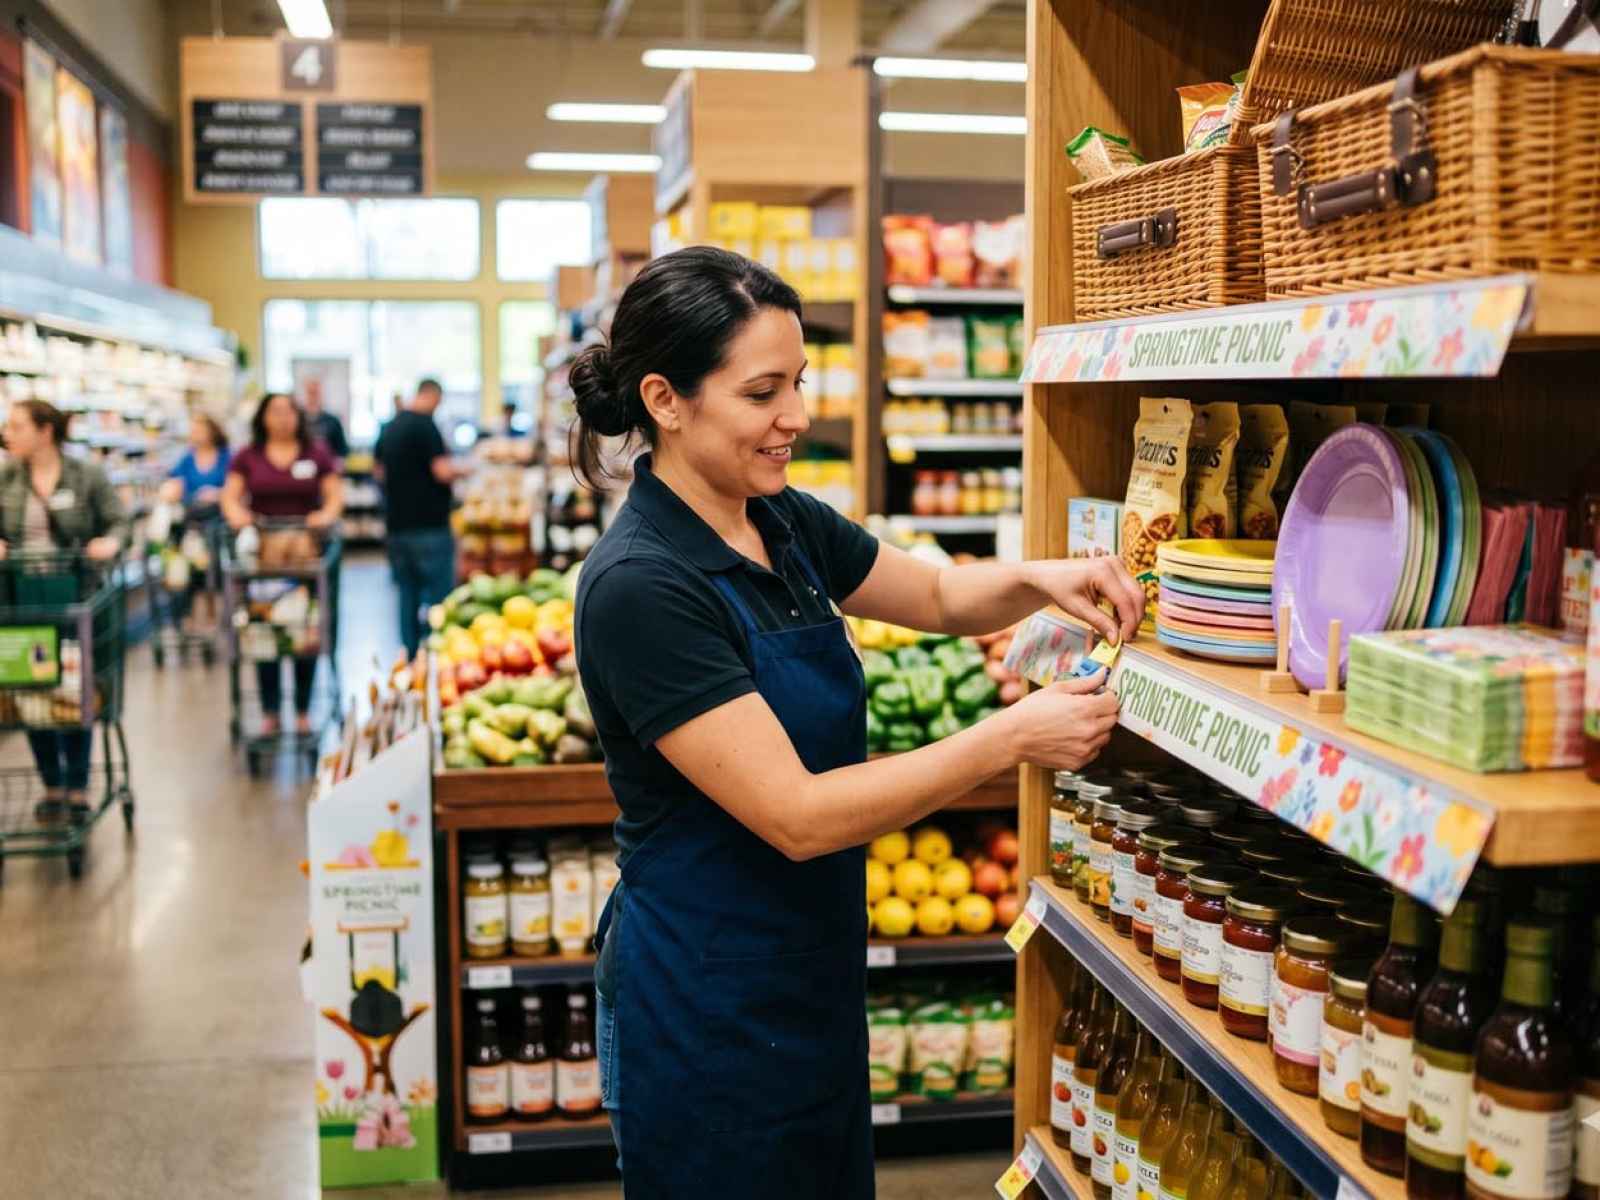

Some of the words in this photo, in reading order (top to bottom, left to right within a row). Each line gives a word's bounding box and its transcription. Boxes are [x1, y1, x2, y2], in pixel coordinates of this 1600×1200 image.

[291, 45, 322, 86] 4
[1128, 325, 1228, 368] SPRINGTIME
[1226, 319, 1293, 364] PICNIC
[1116, 668, 1210, 747] SPRINGTIME
[1202, 711, 1271, 778] PICNIC
[323, 882, 421, 898] SPRINGTIME
[345, 898, 398, 911] PICNIC
